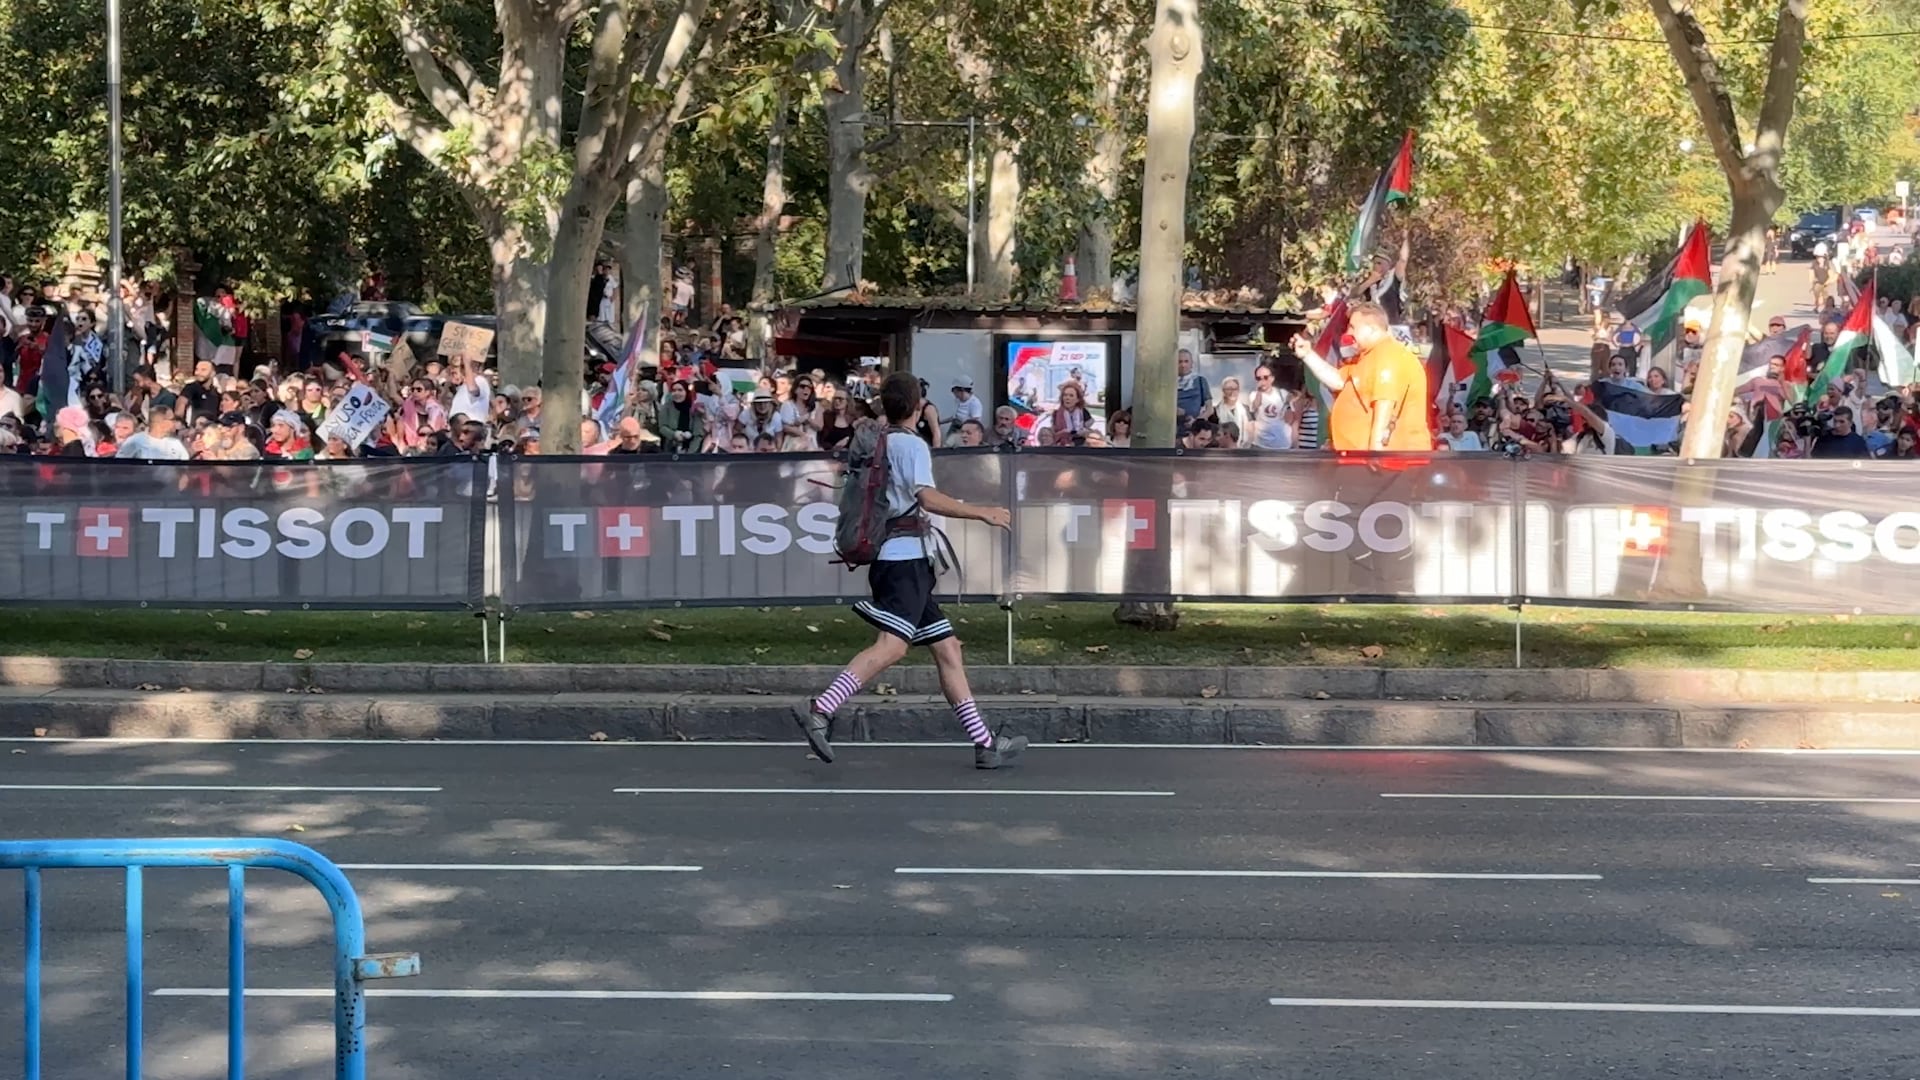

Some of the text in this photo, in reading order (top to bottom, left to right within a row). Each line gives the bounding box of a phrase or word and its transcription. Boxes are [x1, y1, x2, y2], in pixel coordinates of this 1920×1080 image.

[26, 507, 443, 559] T TISSOT
[550, 502, 840, 556] T TISS
